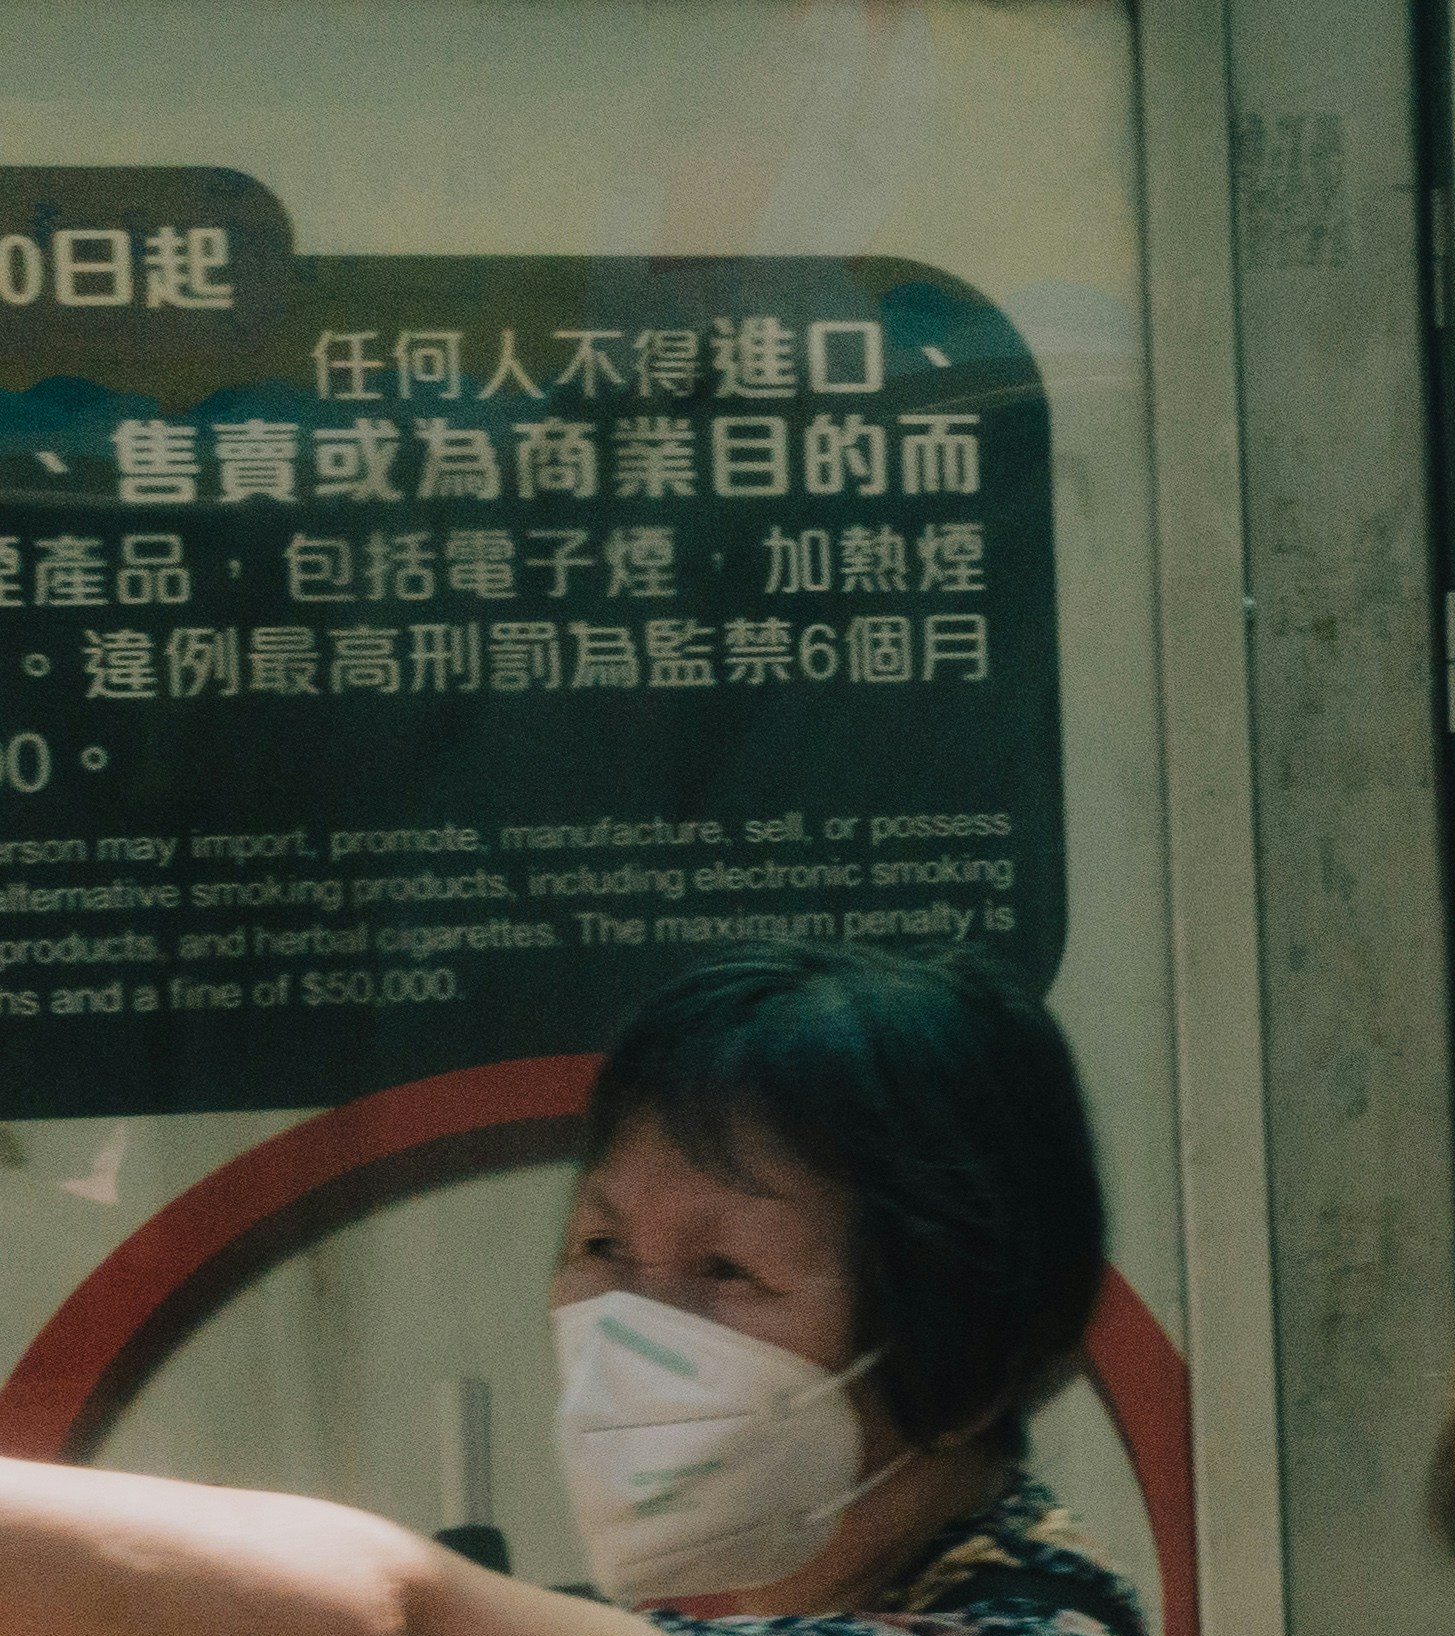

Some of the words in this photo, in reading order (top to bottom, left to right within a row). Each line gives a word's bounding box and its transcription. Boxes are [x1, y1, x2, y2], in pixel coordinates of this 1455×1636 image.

[0, 228, 234, 307] 0日起
[313, 316, 951, 400] 任何人不得進口、
[0, 731, 110, 793] 0。
[96, 836, 179, 868] may
[822, 815, 860, 841] or
[869, 812, 1012, 847] possess
[191, 874, 343, 913] smoking
[529, 862, 685, 900] including
[694, 856, 863, 893] electronic
[869, 853, 1016, 892] smoking
[178, 927, 245, 960] and
[254, 923, 367, 956] herbal
[574, 910, 645, 946] The
[655, 905, 834, 943] maximum
[844, 900, 974, 943] penalty
[983, 901, 1016, 933] is
[51, 980, 122, 1015] and
[133, 986, 158, 1012] a
[170, 975, 242, 1010] fine
[253, 973, 291, 1009] of
